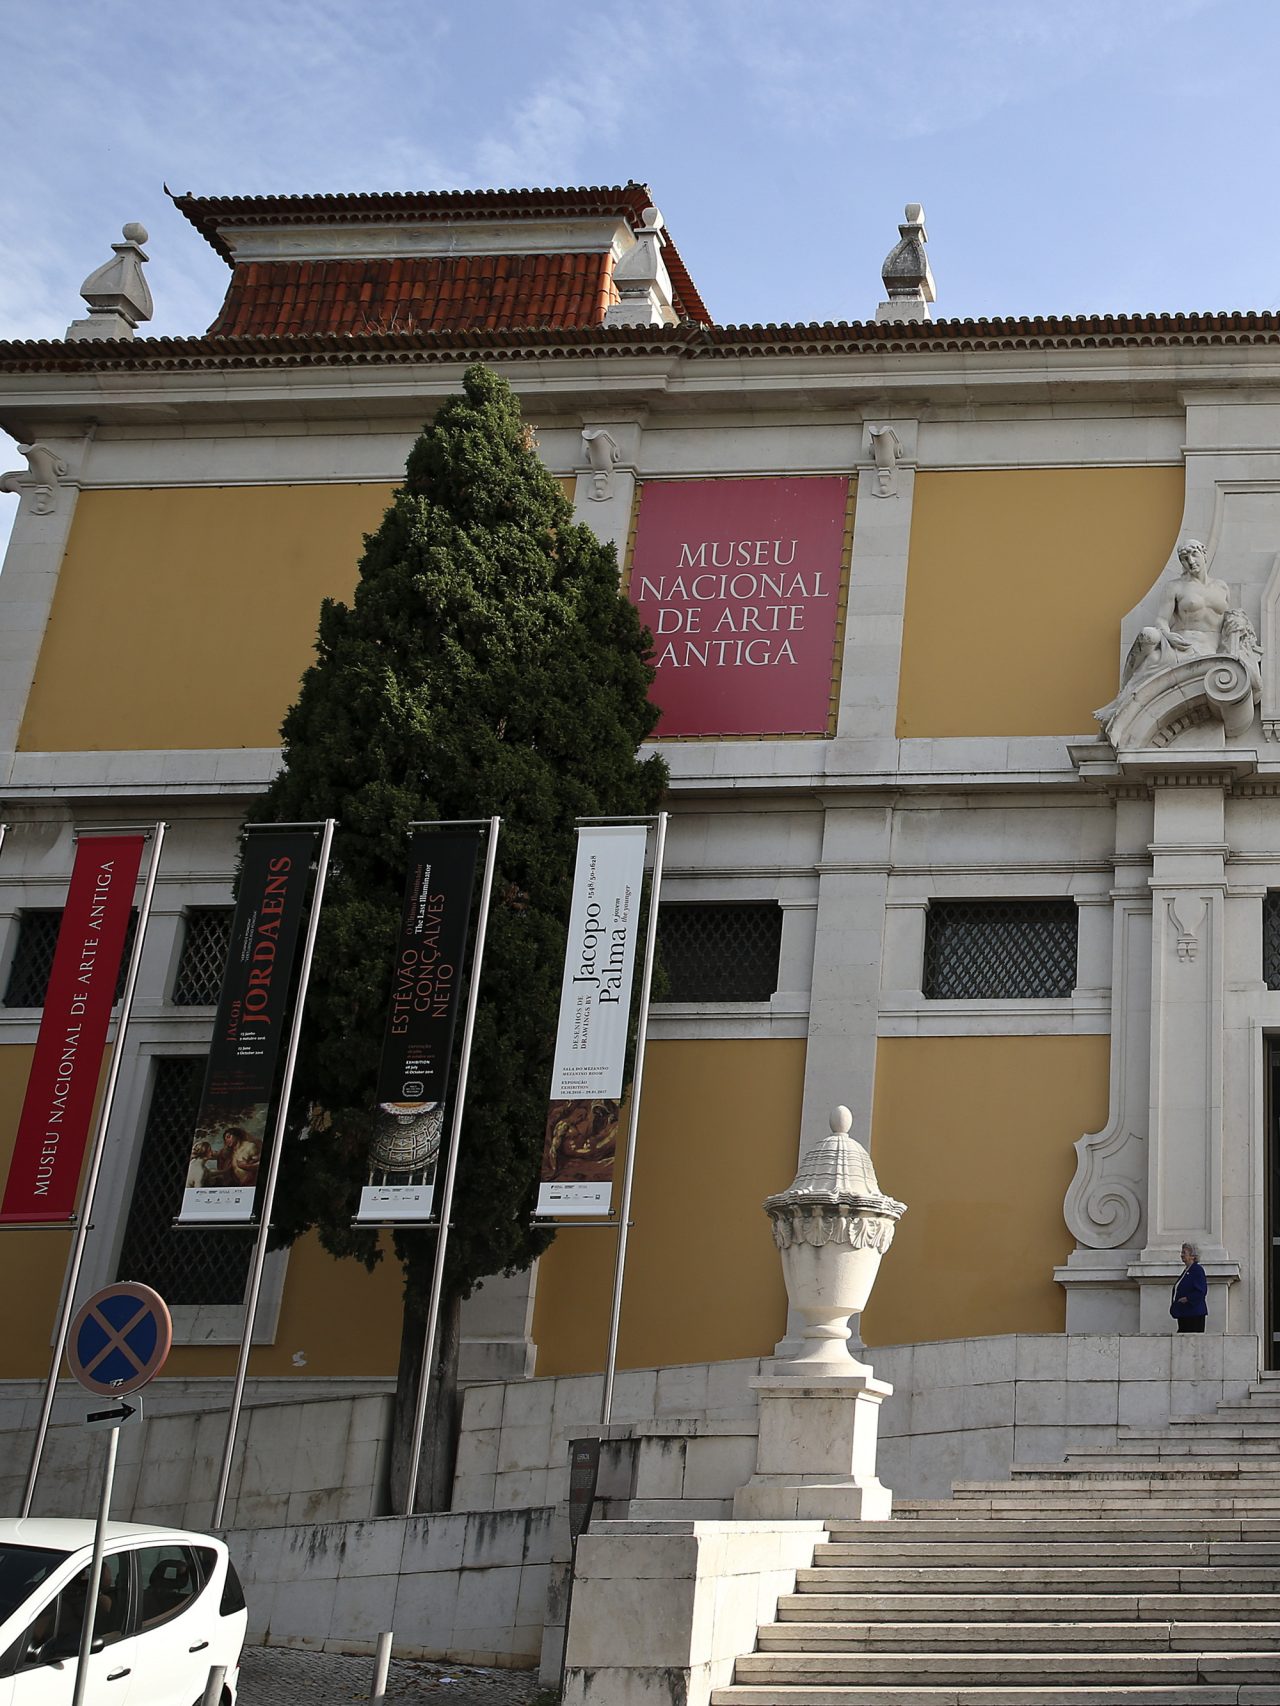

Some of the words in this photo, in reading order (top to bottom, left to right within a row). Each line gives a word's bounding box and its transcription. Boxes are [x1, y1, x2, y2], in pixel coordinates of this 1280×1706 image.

[676, 540, 798, 568] MUSEU
[638, 572, 829, 601] NACIONAL
[656, 607, 701, 635] DE
[712, 605, 805, 633] ARTE
[655, 639, 799, 669] ANTIGA
[88, 860, 115, 931] ANTIGA
[420, 863, 432, 903] Illuminator
[623, 885, 632, 911] younger
[415, 920, 424, 935] The
[417, 903, 426, 919] Last
[611, 898, 621, 918] jovem
[243, 855, 293, 1025] JORDAENS
[414, 893, 446, 1012] GONÇALVES
[572, 903, 607, 988] Jacopo
[74, 937, 99, 986] ARTE
[598, 927, 627, 1005] Palma
[70, 991, 88, 1016] DE
[392, 949, 418, 1034] ESTÊVÃO
[431, 963, 454, 1018] NETO
[576, 994, 584, 1006] DE
[585, 994, 592, 1005] BY
[226, 1000, 241, 1041] JACOB
[572, 1007, 583, 1050] DESENHOS
[580, 1007, 591, 1050] DRAWINGS
[48, 1021, 83, 1124] NACIONAL
[34, 1131, 60, 1196] MUSEU
